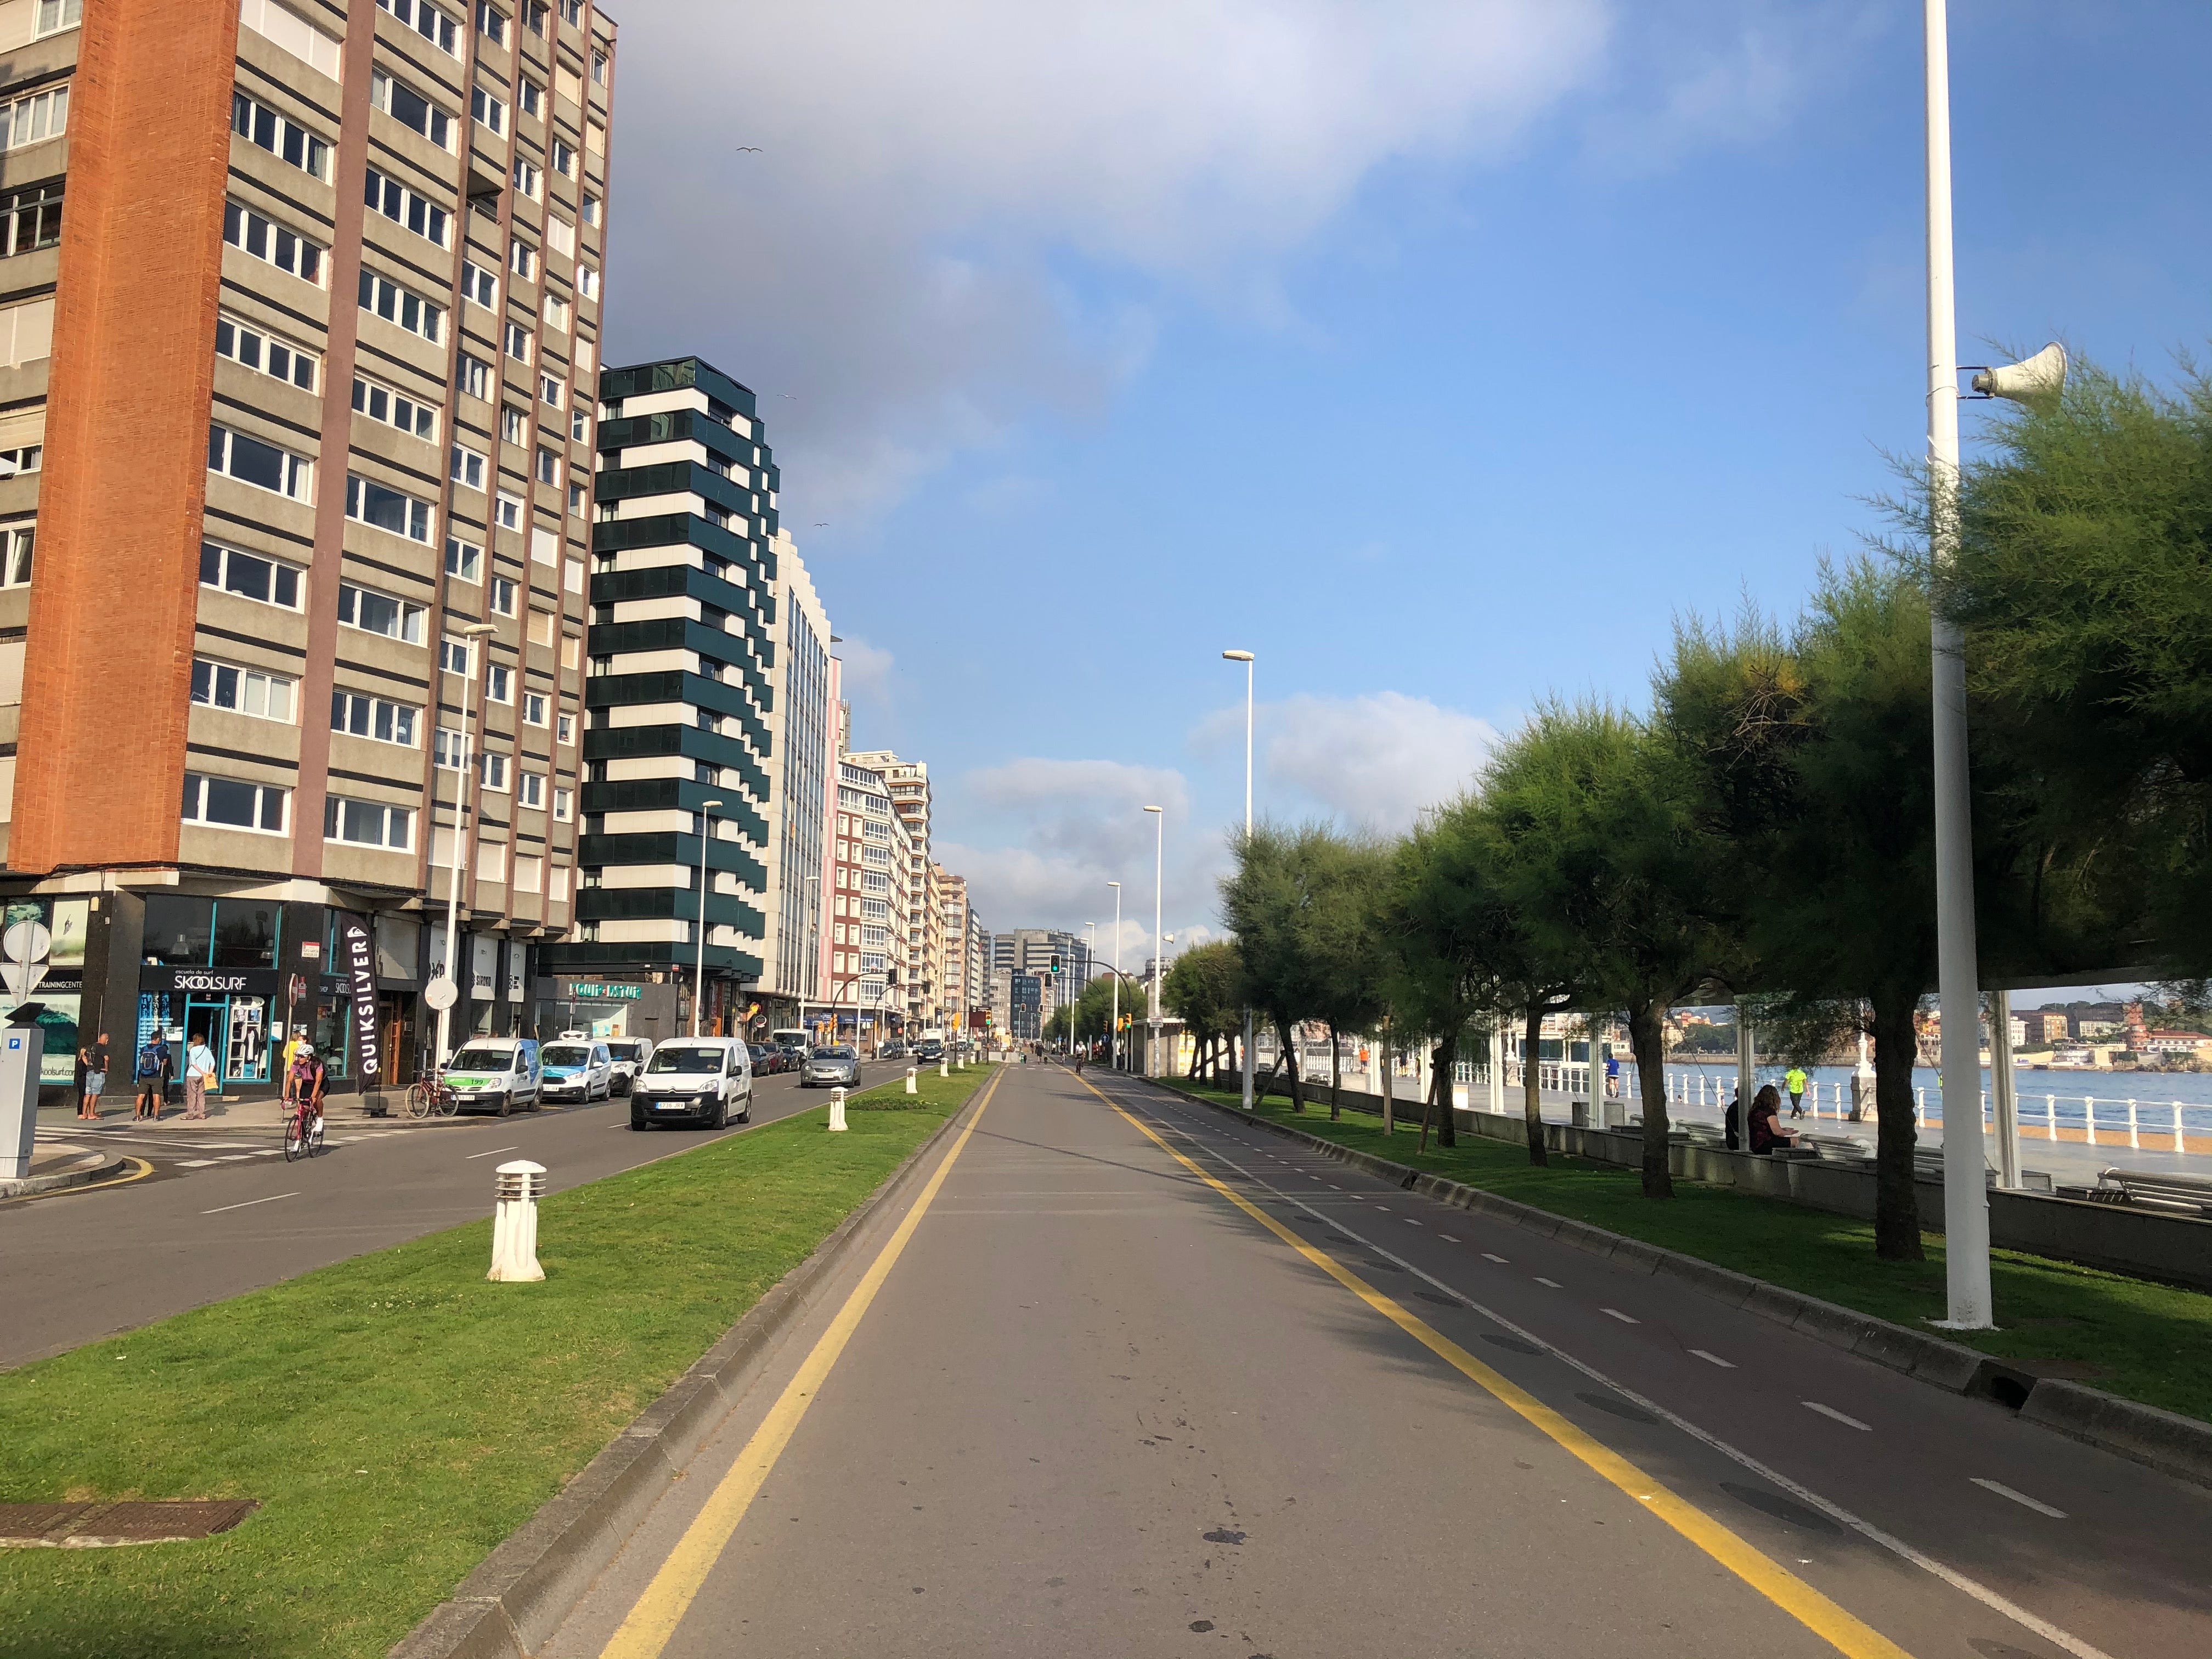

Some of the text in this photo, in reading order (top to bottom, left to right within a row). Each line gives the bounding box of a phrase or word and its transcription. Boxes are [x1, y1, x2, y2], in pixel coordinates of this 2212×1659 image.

[174, 975, 247, 990] SKOOLSURF
[476, 975, 492, 987] SIROKO
[352, 940, 378, 1074] QUIKSILVER
[40, 1066, 75, 1076] koolsurf.co
